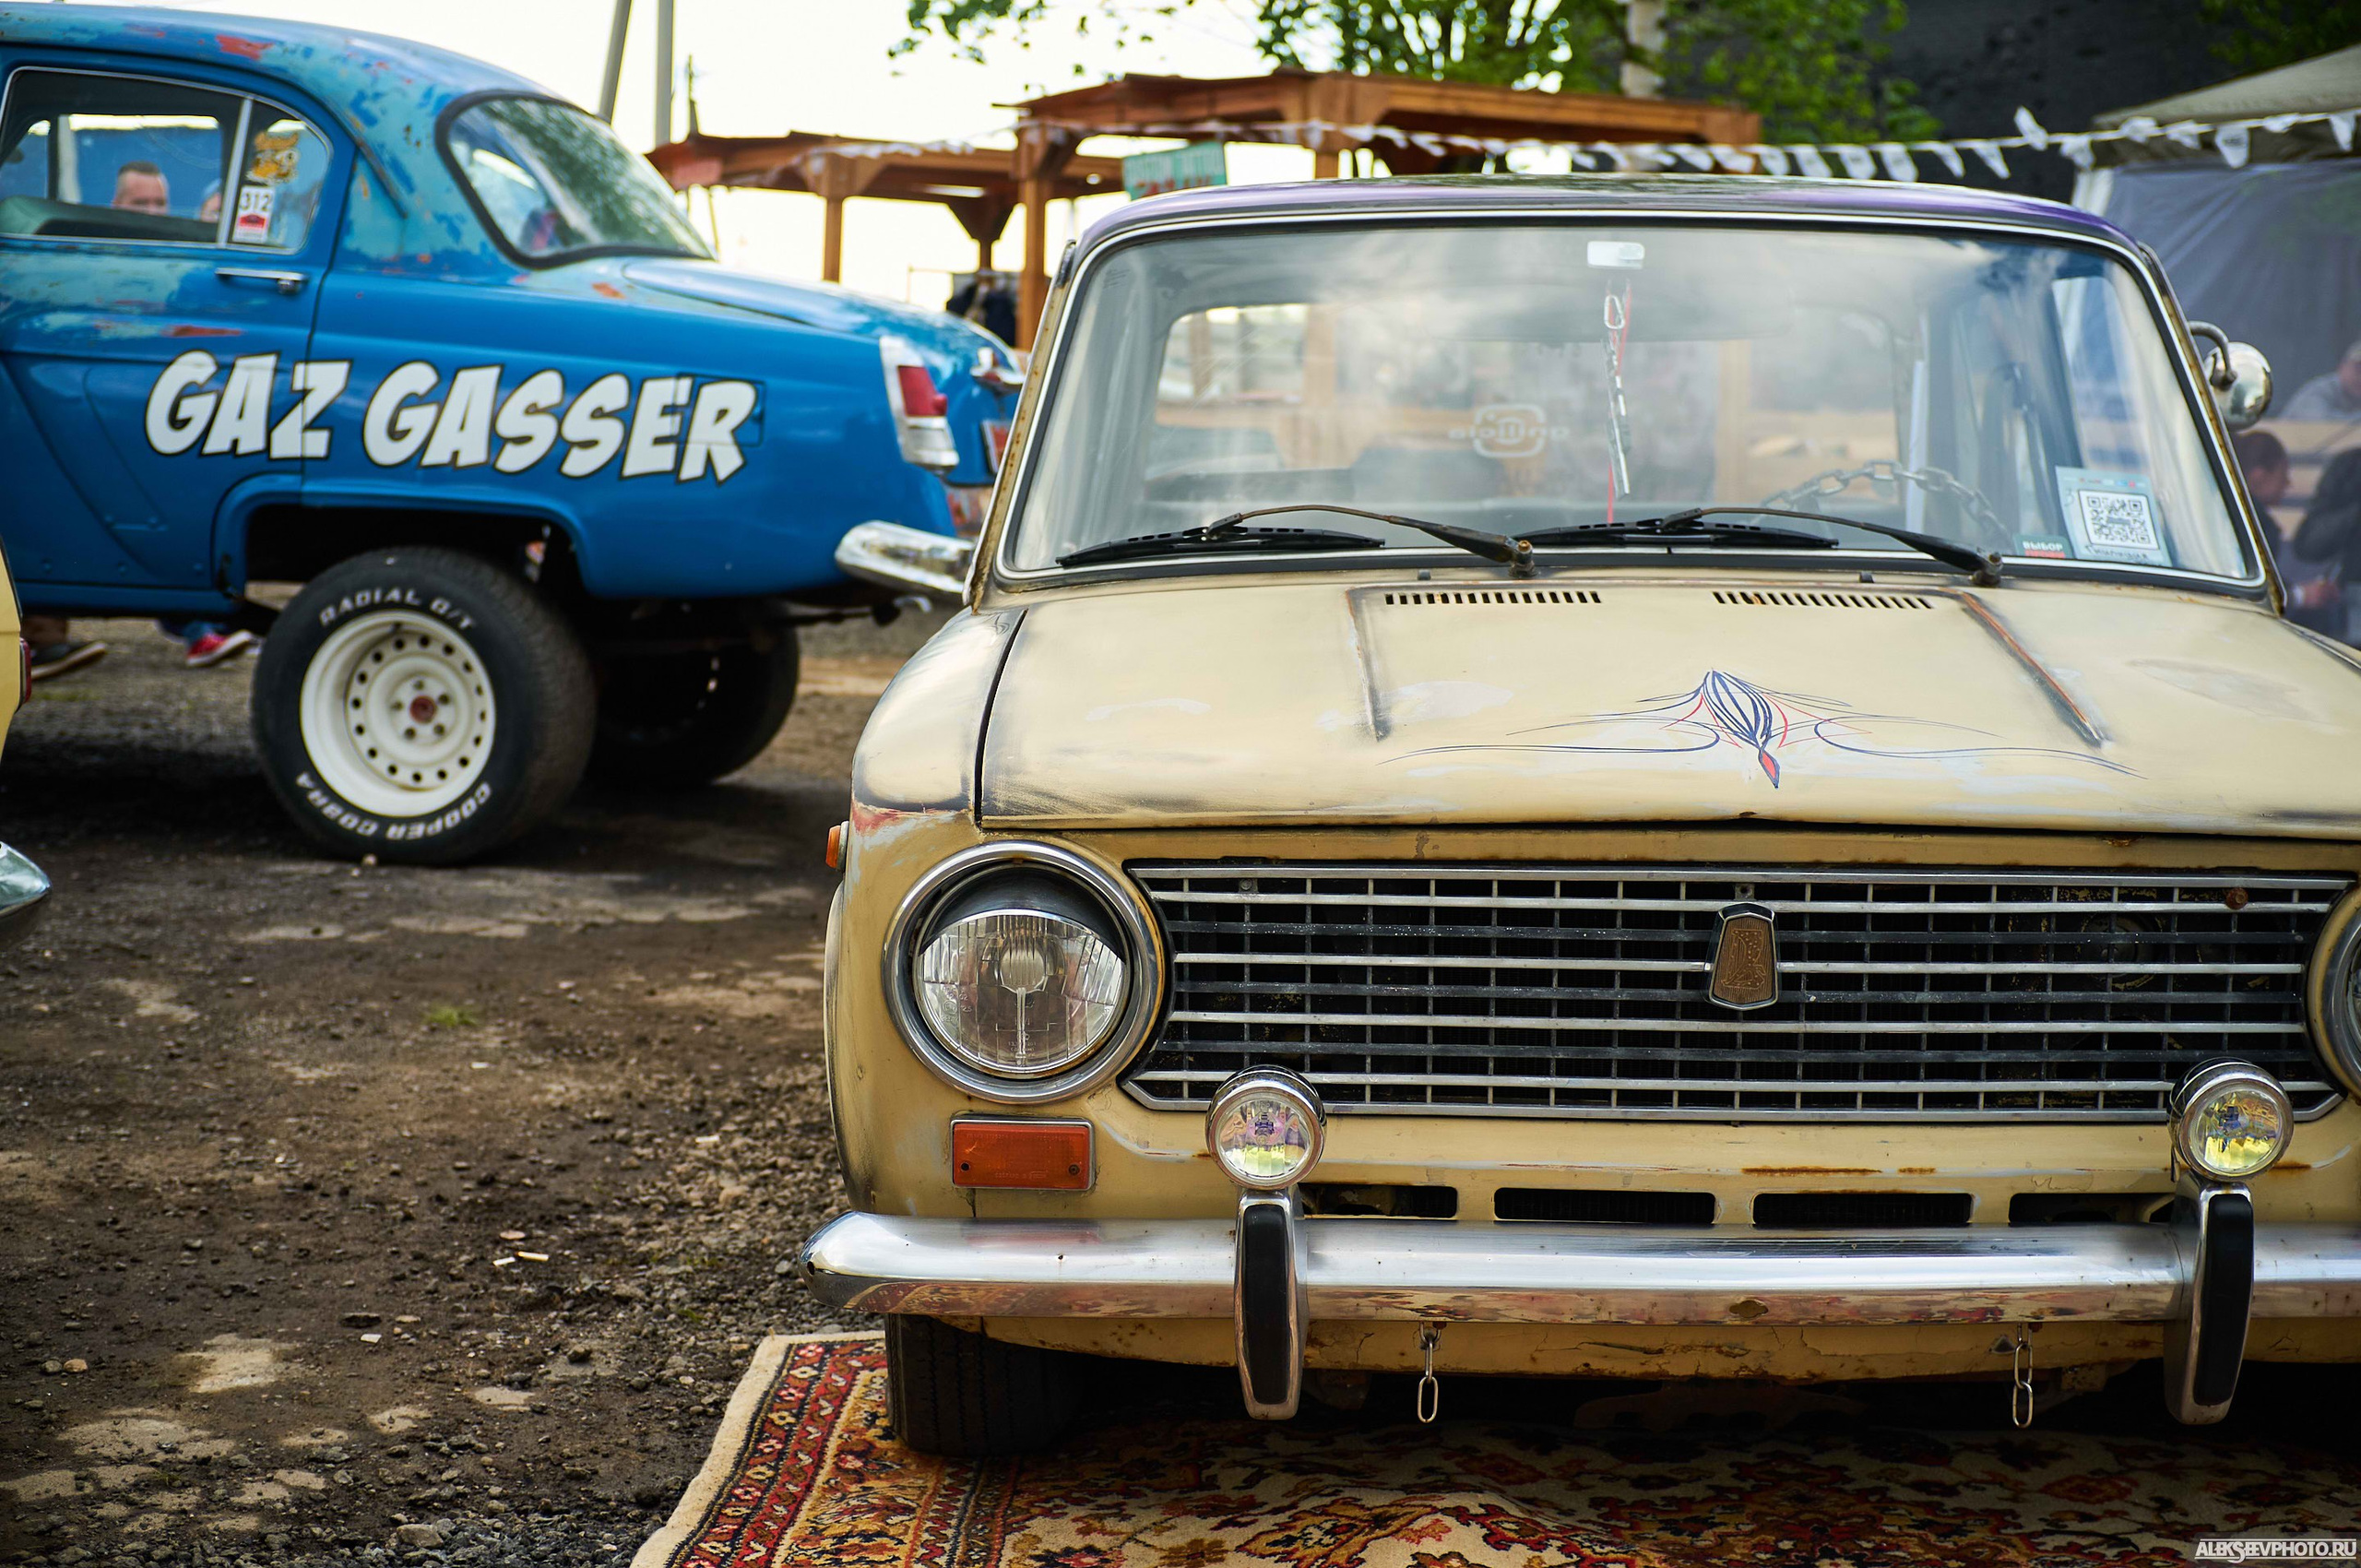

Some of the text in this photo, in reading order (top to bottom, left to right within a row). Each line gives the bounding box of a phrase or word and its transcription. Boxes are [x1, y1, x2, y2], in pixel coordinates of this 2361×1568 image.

[240, 192, 272, 212] 312
[146, 349, 758, 485] GAZ GASSER
[2023, 540, 2063, 552] ВЫБОР
[318, 586, 422, 628] RADIAL
[295, 770, 492, 840] COOPER COBRA
